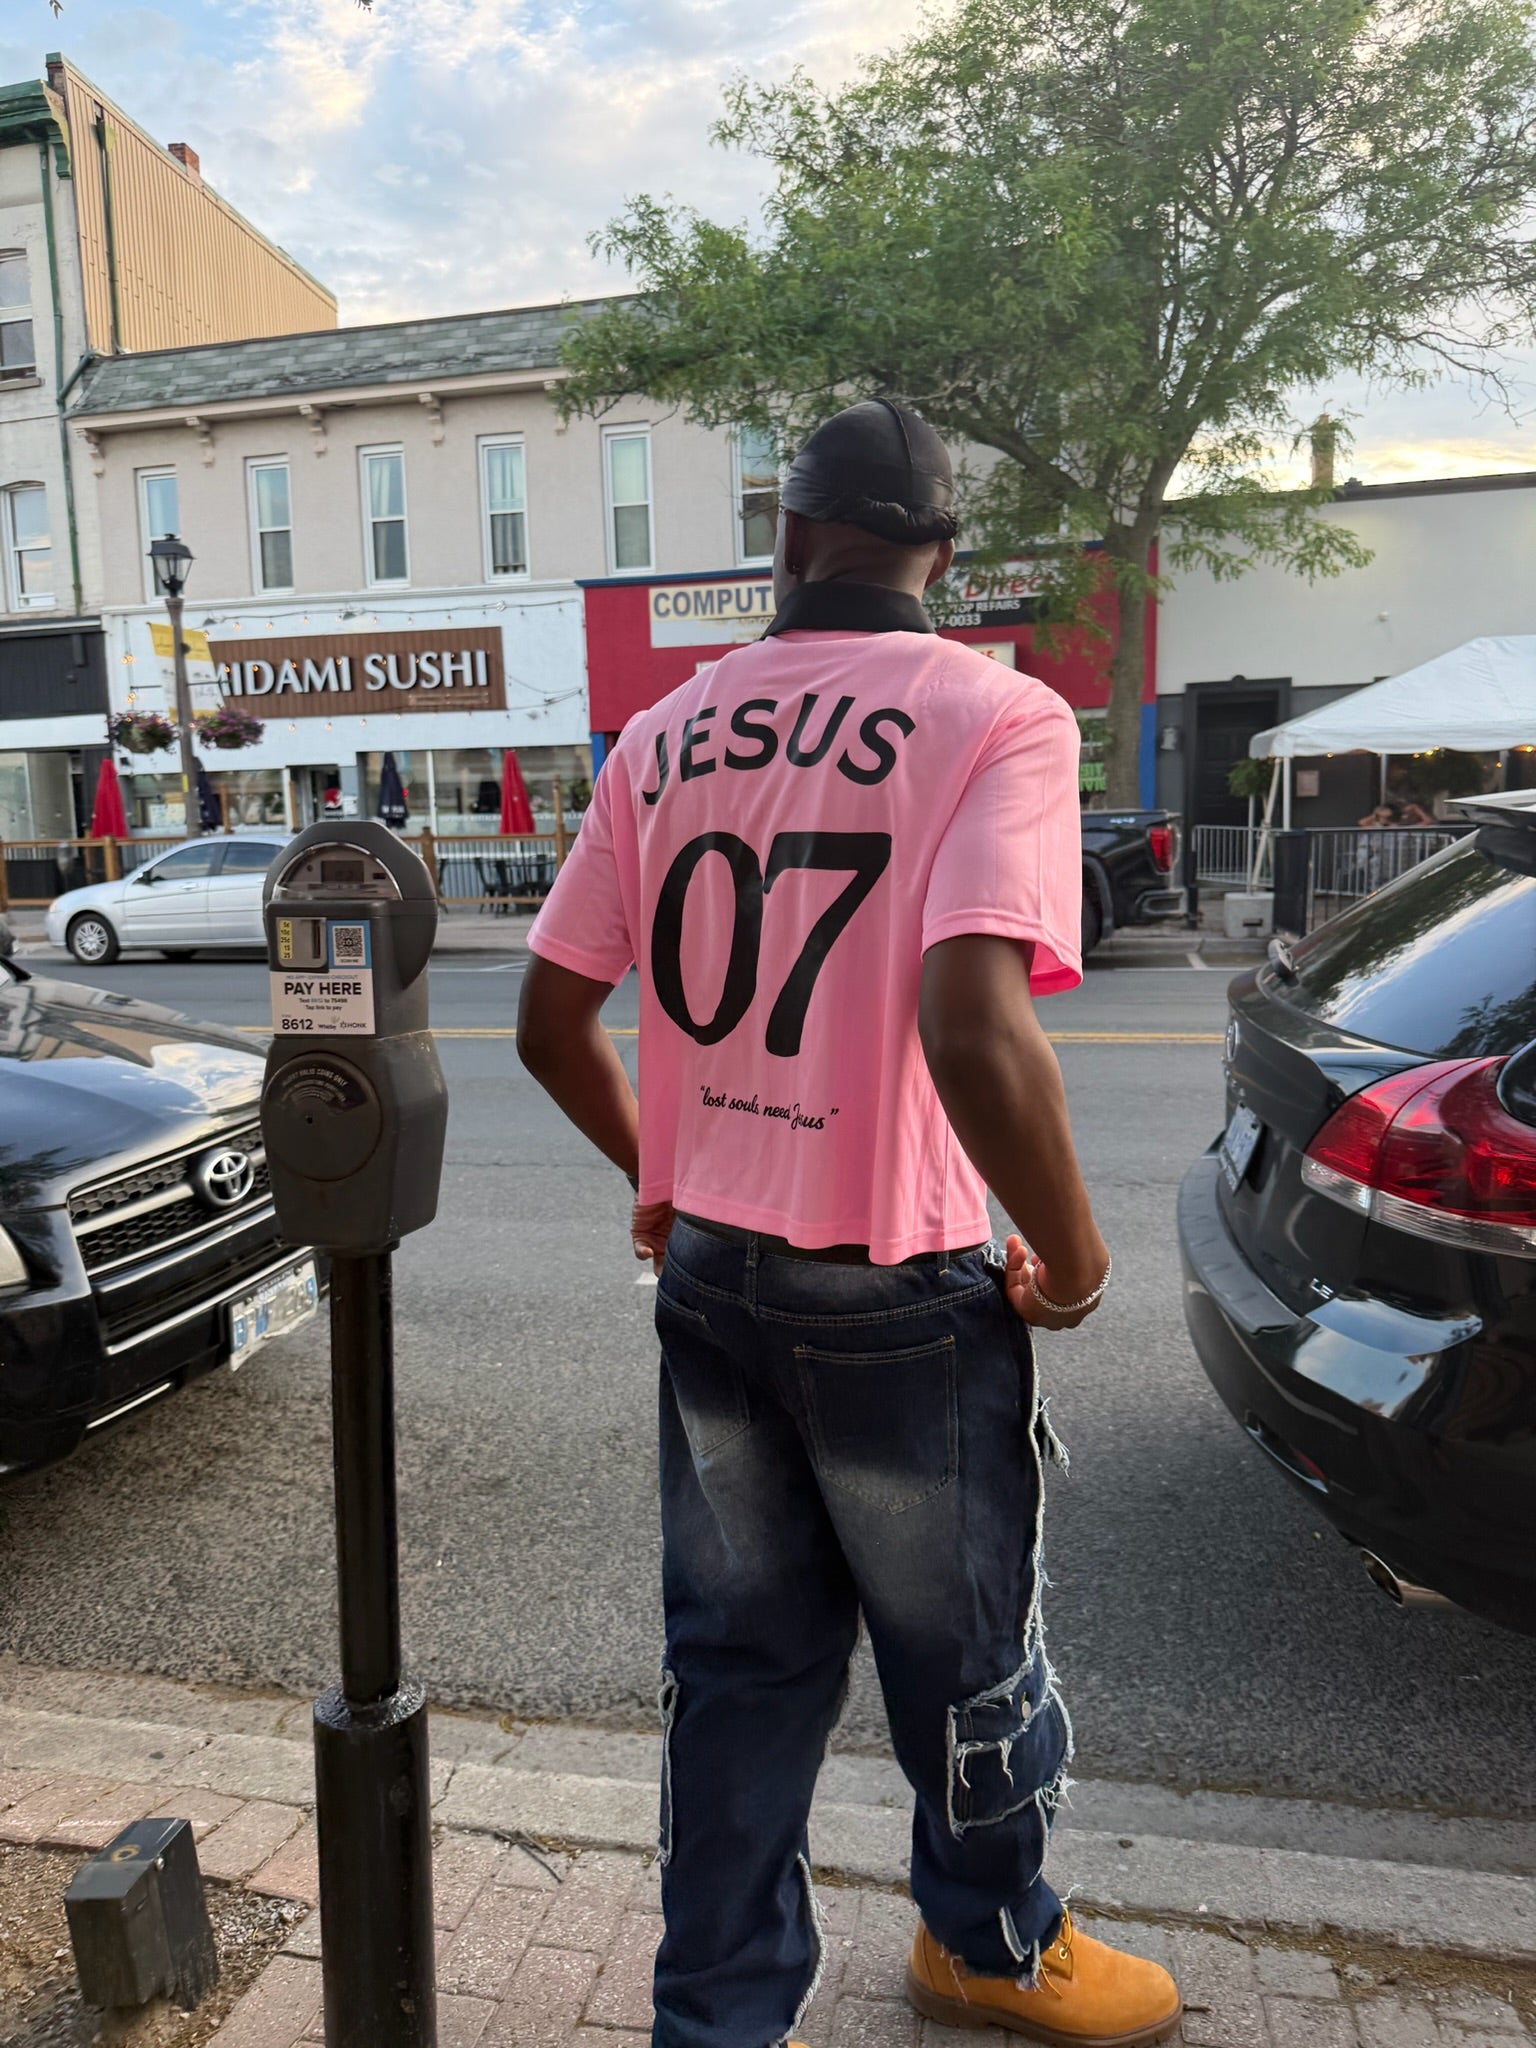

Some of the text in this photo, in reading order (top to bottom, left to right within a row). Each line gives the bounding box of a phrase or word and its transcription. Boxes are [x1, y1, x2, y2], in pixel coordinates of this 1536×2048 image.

[976, 600, 1021, 612] REPAIRS
[363, 650, 489, 692] SUSHI
[642, 693, 916, 805] JESUS
[651, 831, 892, 1058] 07
[284, 982, 362, 995] PAY HERE
[281, 1018, 314, 1030] 8612
[763, 1104, 791, 1120] need
[1309, 1277, 1334, 1299] LE
